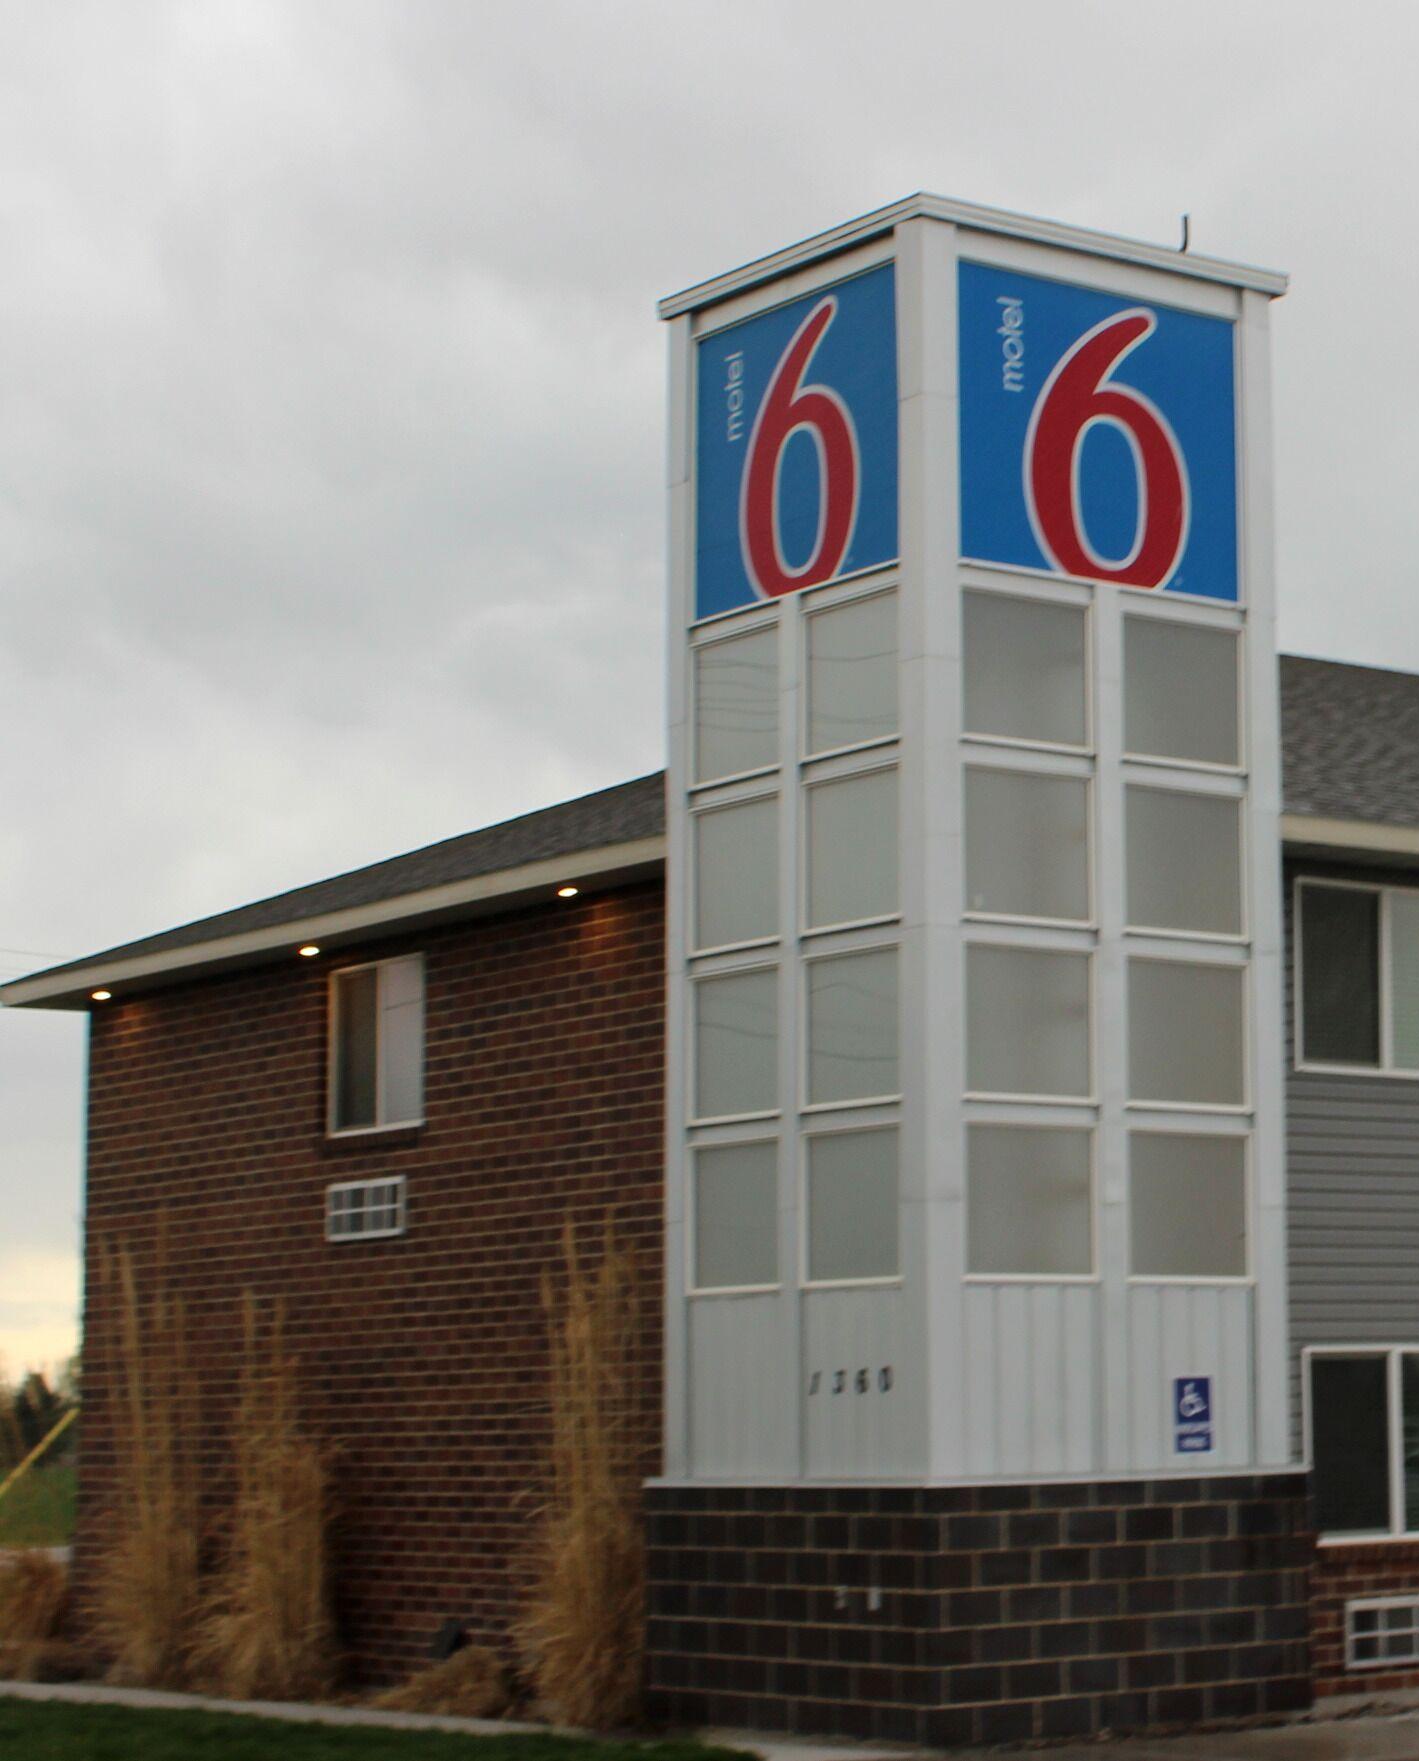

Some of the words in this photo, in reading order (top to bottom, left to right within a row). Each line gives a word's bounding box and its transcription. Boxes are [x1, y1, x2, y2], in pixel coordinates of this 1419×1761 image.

[724, 350, 744, 442] motel
[996, 296, 1024, 392] motel
[739, 295, 861, 601] 6
[1022, 306, 1192, 591] 6
